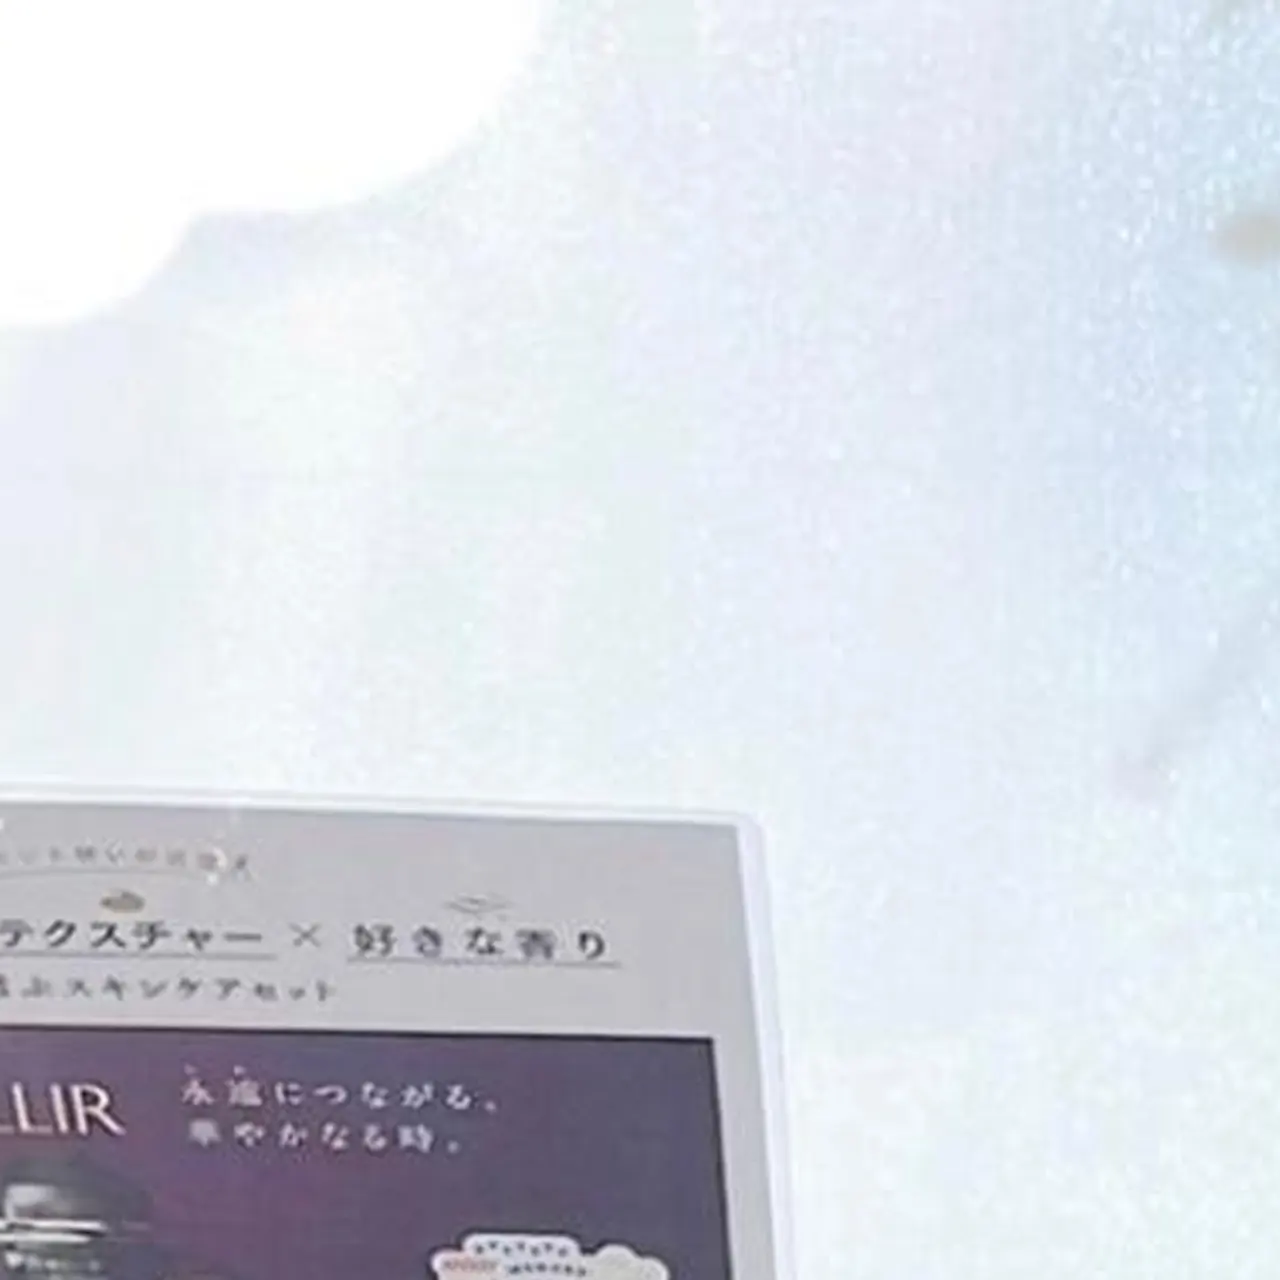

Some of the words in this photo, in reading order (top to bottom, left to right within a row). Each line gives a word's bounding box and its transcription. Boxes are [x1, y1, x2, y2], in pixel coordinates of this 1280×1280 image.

[352, 923, 607, 961] 好きな香り
